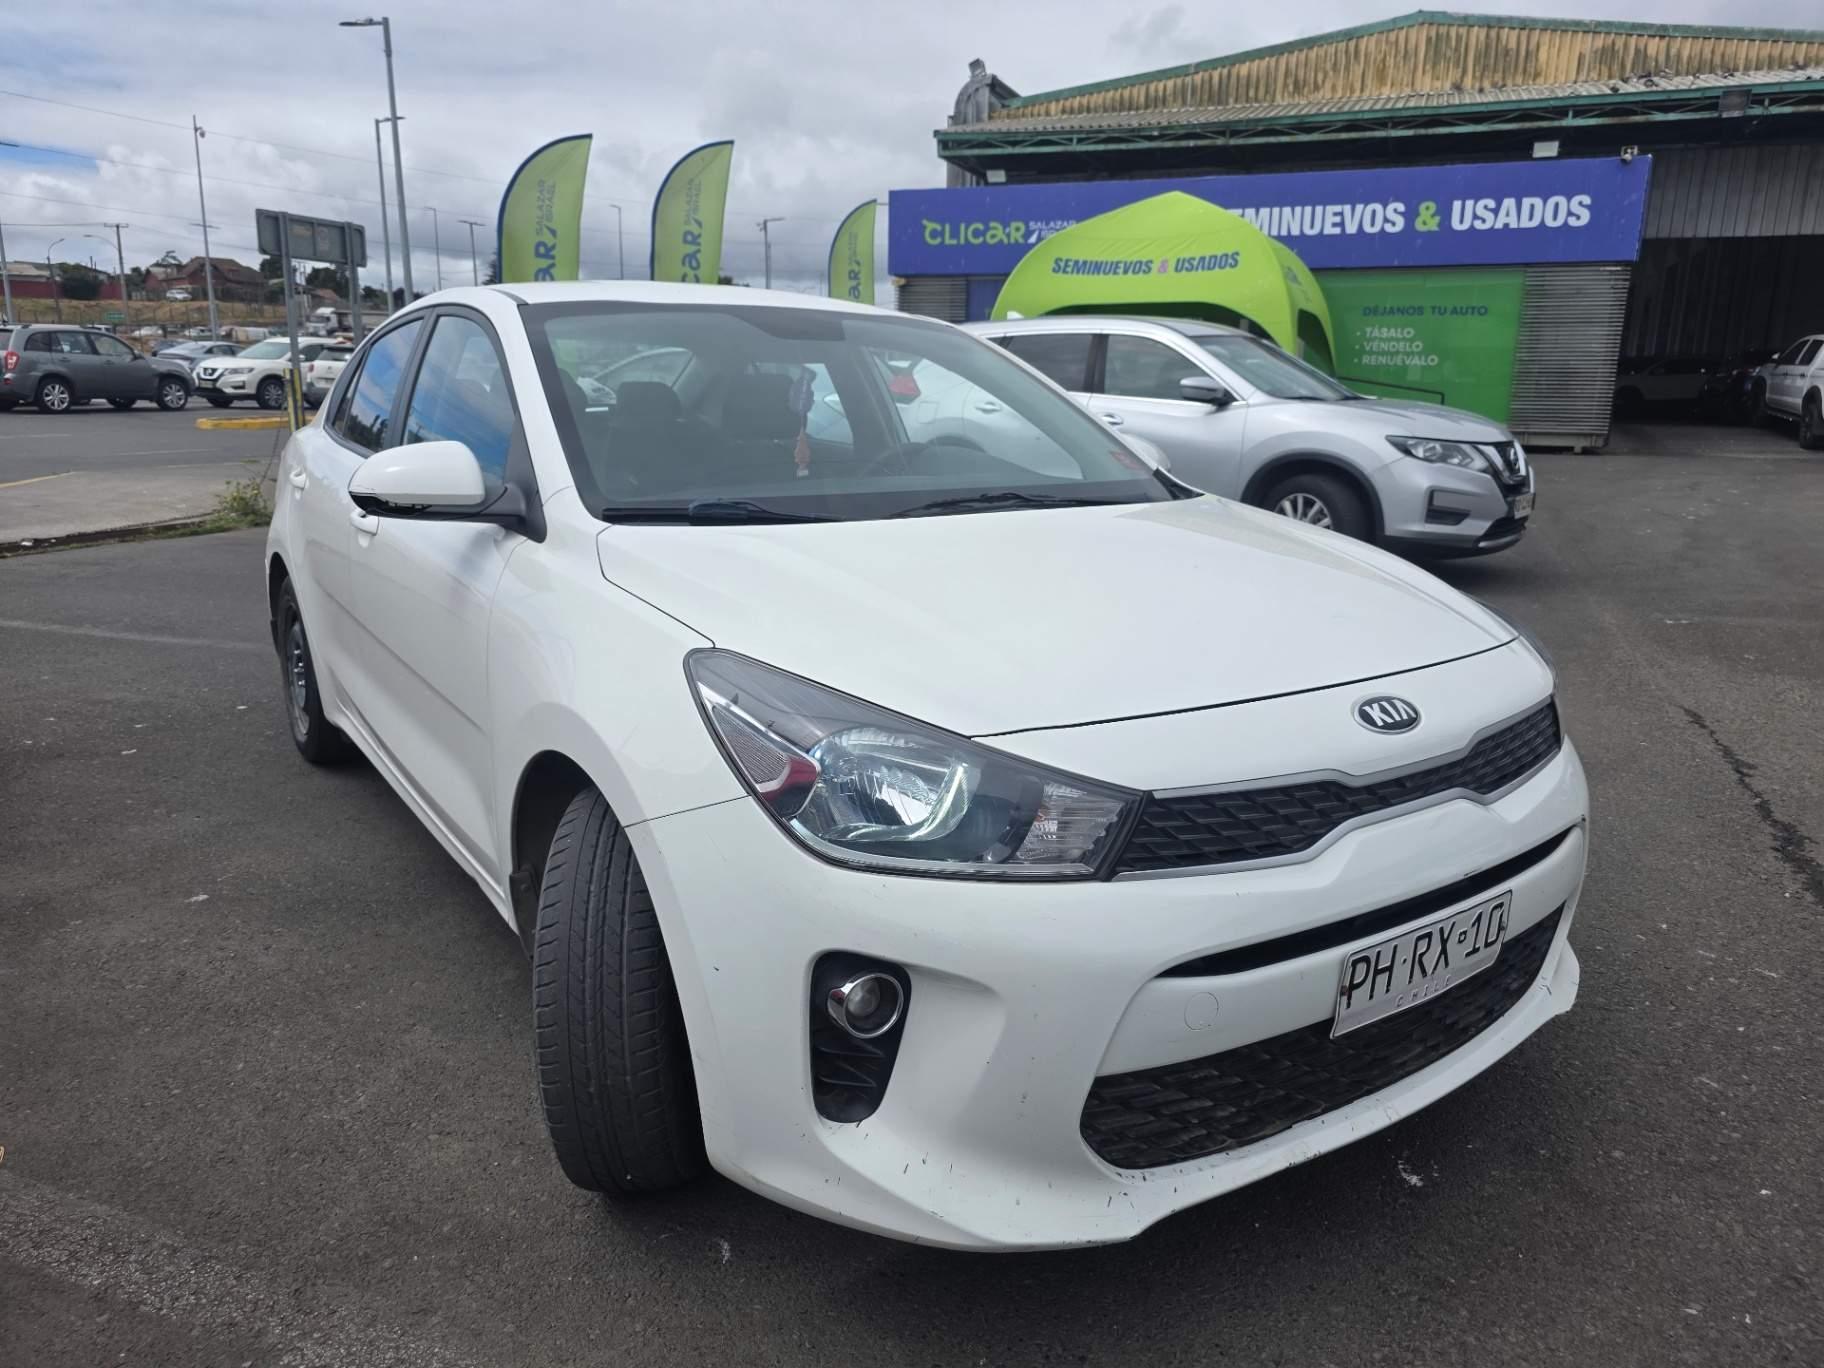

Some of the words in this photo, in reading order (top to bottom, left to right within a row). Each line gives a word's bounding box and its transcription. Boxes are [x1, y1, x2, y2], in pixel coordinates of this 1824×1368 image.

[1414, 201, 1440, 232] &
[1450, 195, 1592, 231] USADOS
[1052, 257, 1153, 276] SEMINUEVOS
[1157, 258, 1169, 273] &
[1174, 251, 1240, 273] USADOS
[1430, 305, 1448, 316] TU
[1450, 305, 1488, 316] AUTO
[1365, 325, 1415, 338] TÁSALO
[1362, 699, 1417, 727] KIA
